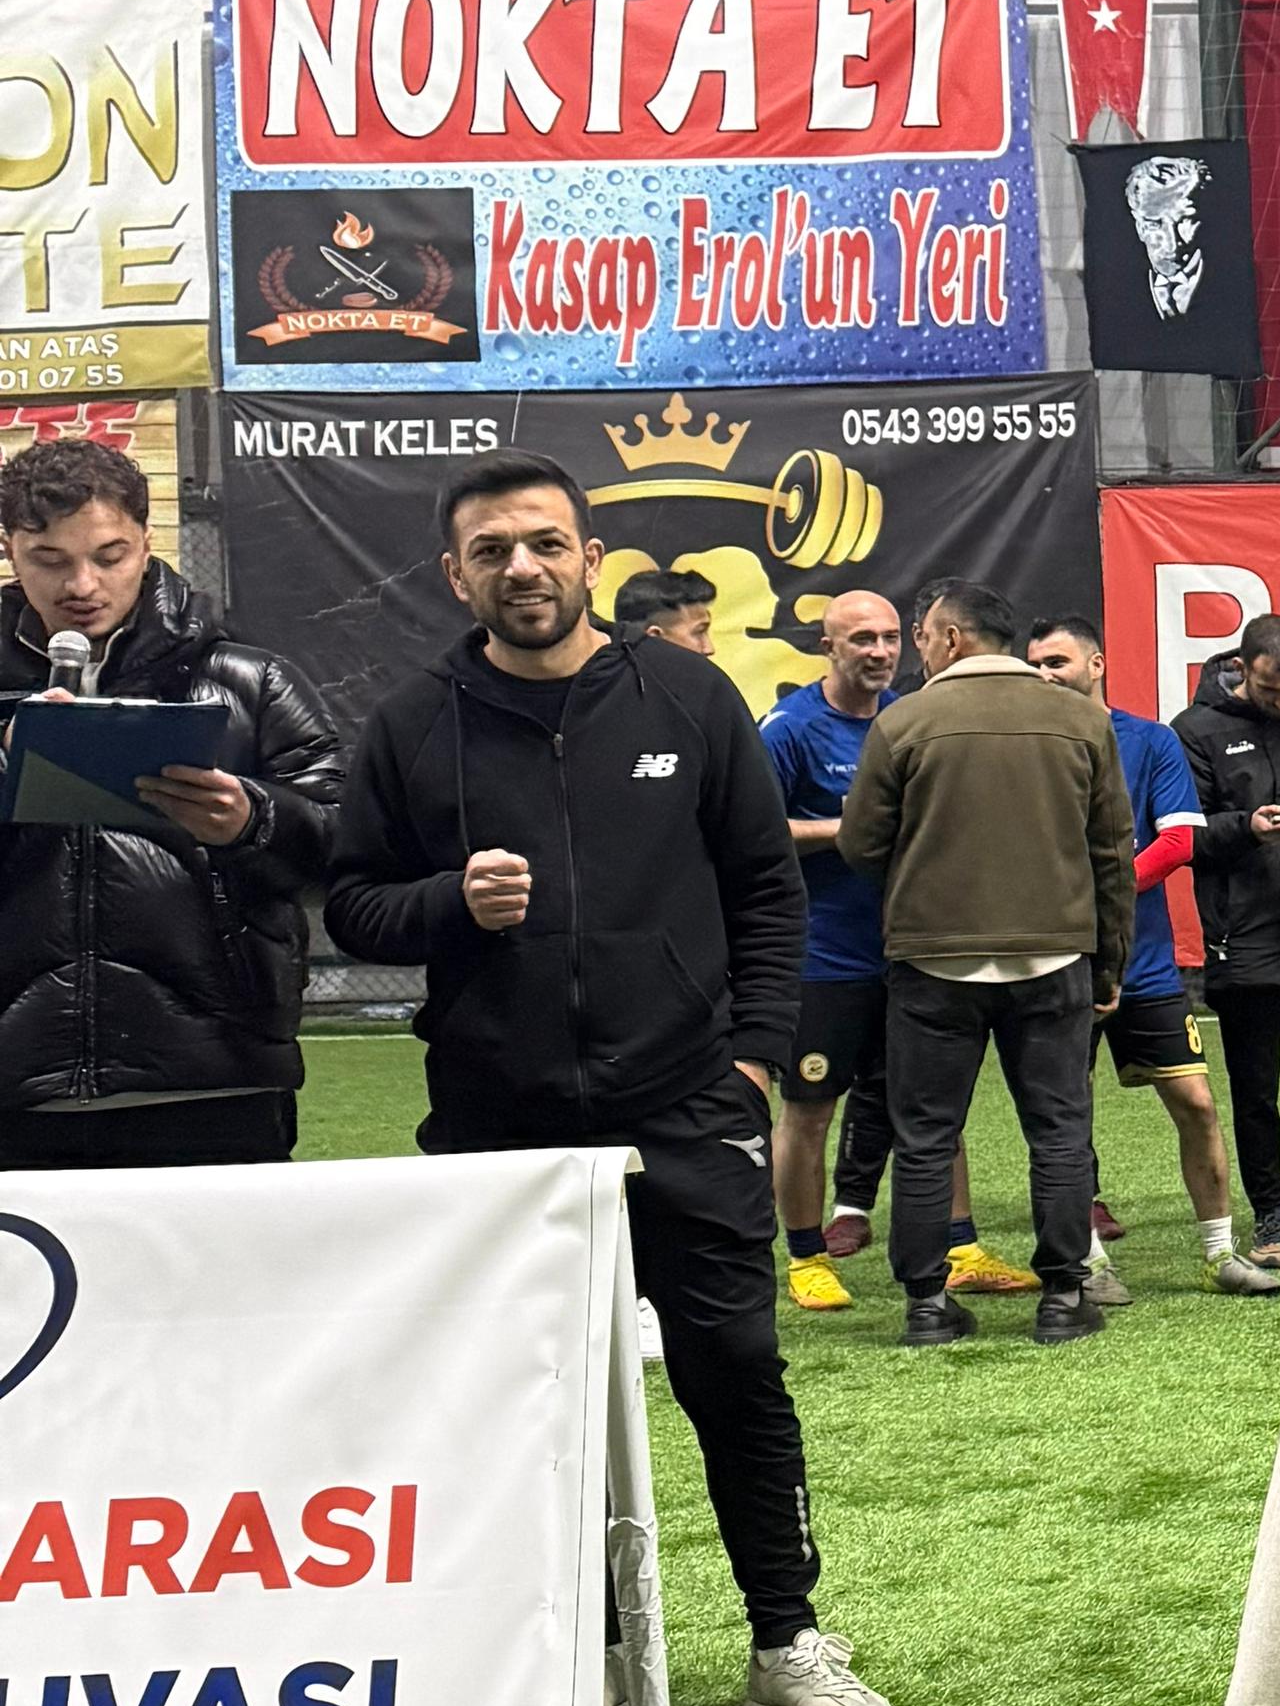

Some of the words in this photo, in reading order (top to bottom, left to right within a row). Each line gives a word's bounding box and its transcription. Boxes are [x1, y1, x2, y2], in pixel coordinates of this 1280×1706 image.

[484, 197, 657, 367] Kasap
[673, 183, 876, 332] Erol'un
[890, 178, 1008, 327] Yeri
[287, 312, 380, 332] NOKTA
[389, 312, 427, 331] ET
[0, 340, 30, 361] N
[41, 335, 119, 359] ATAŞ
[39, 367, 75, 389] 07
[86, 365, 123, 386] 55
[233, 419, 366, 457] MURAT
[373, 417, 498, 454] KELES
[842, 405, 920, 445] 0543
[926, 404, 984, 441] 399
[992, 403, 1030, 440] 55
[1038, 401, 1076, 438] 55
